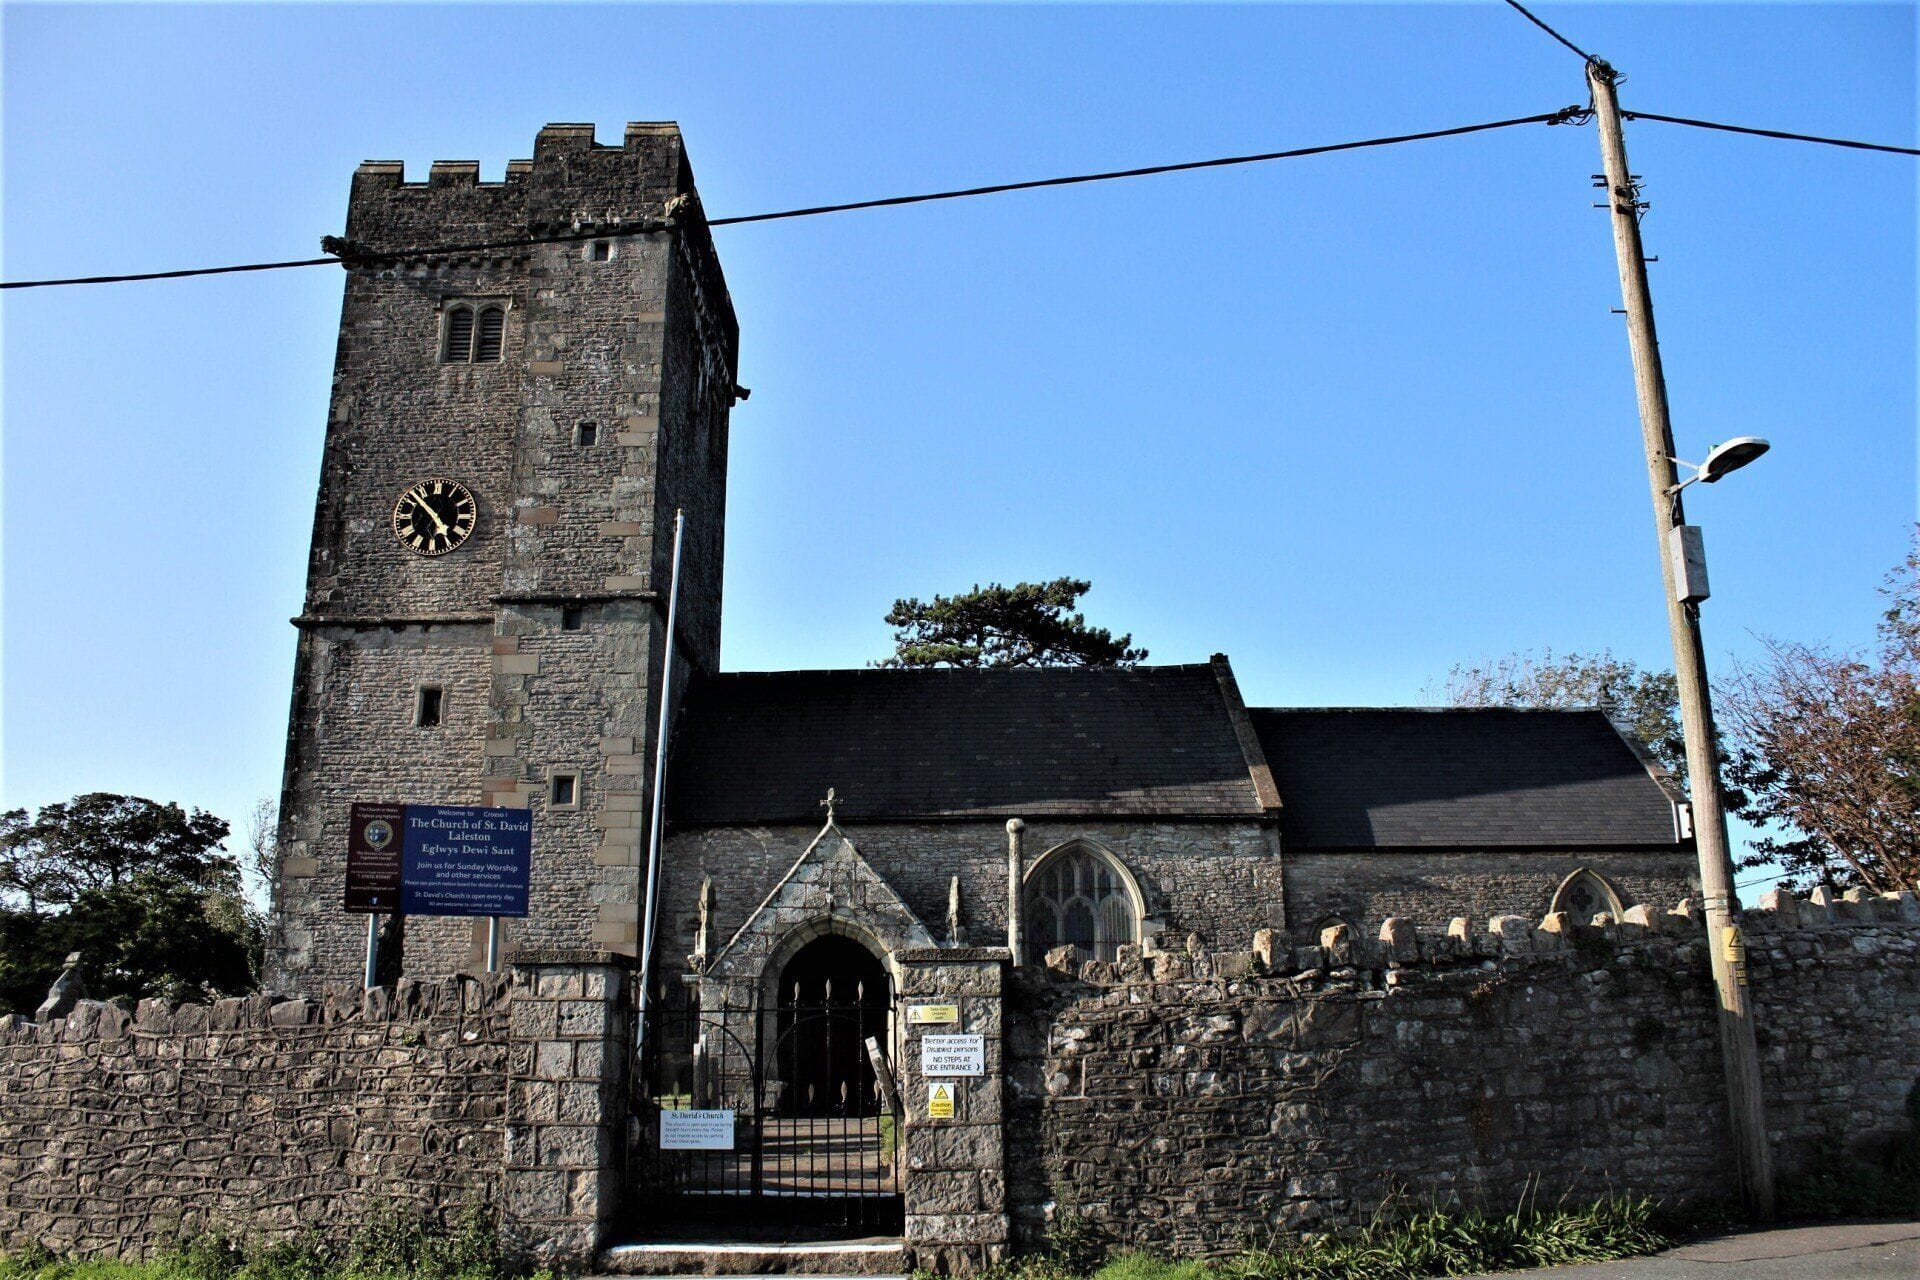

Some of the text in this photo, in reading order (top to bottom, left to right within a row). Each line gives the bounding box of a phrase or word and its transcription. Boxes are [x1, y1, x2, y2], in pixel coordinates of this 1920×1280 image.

[437, 809, 466, 817] Welcome
[410, 817, 529, 831] The Church of St. David
[448, 831, 491, 841] Laleston
[422, 843, 514, 856] Eglwys Dewi Sant
[417, 861, 432, 870] Join
[444, 861, 456, 869] for
[457, 862, 485, 872] Sunday
[486, 863, 518, 873] Worship
[451, 871, 471, 879] other
[473, 872, 501, 880] services
[423, 891, 444, 899] David's
[503, 894, 515, 902] day
[969, 1037, 980, 1045] for
[680, 1111, 701, 1119] David's
[702, 1111, 724, 1119] Church
